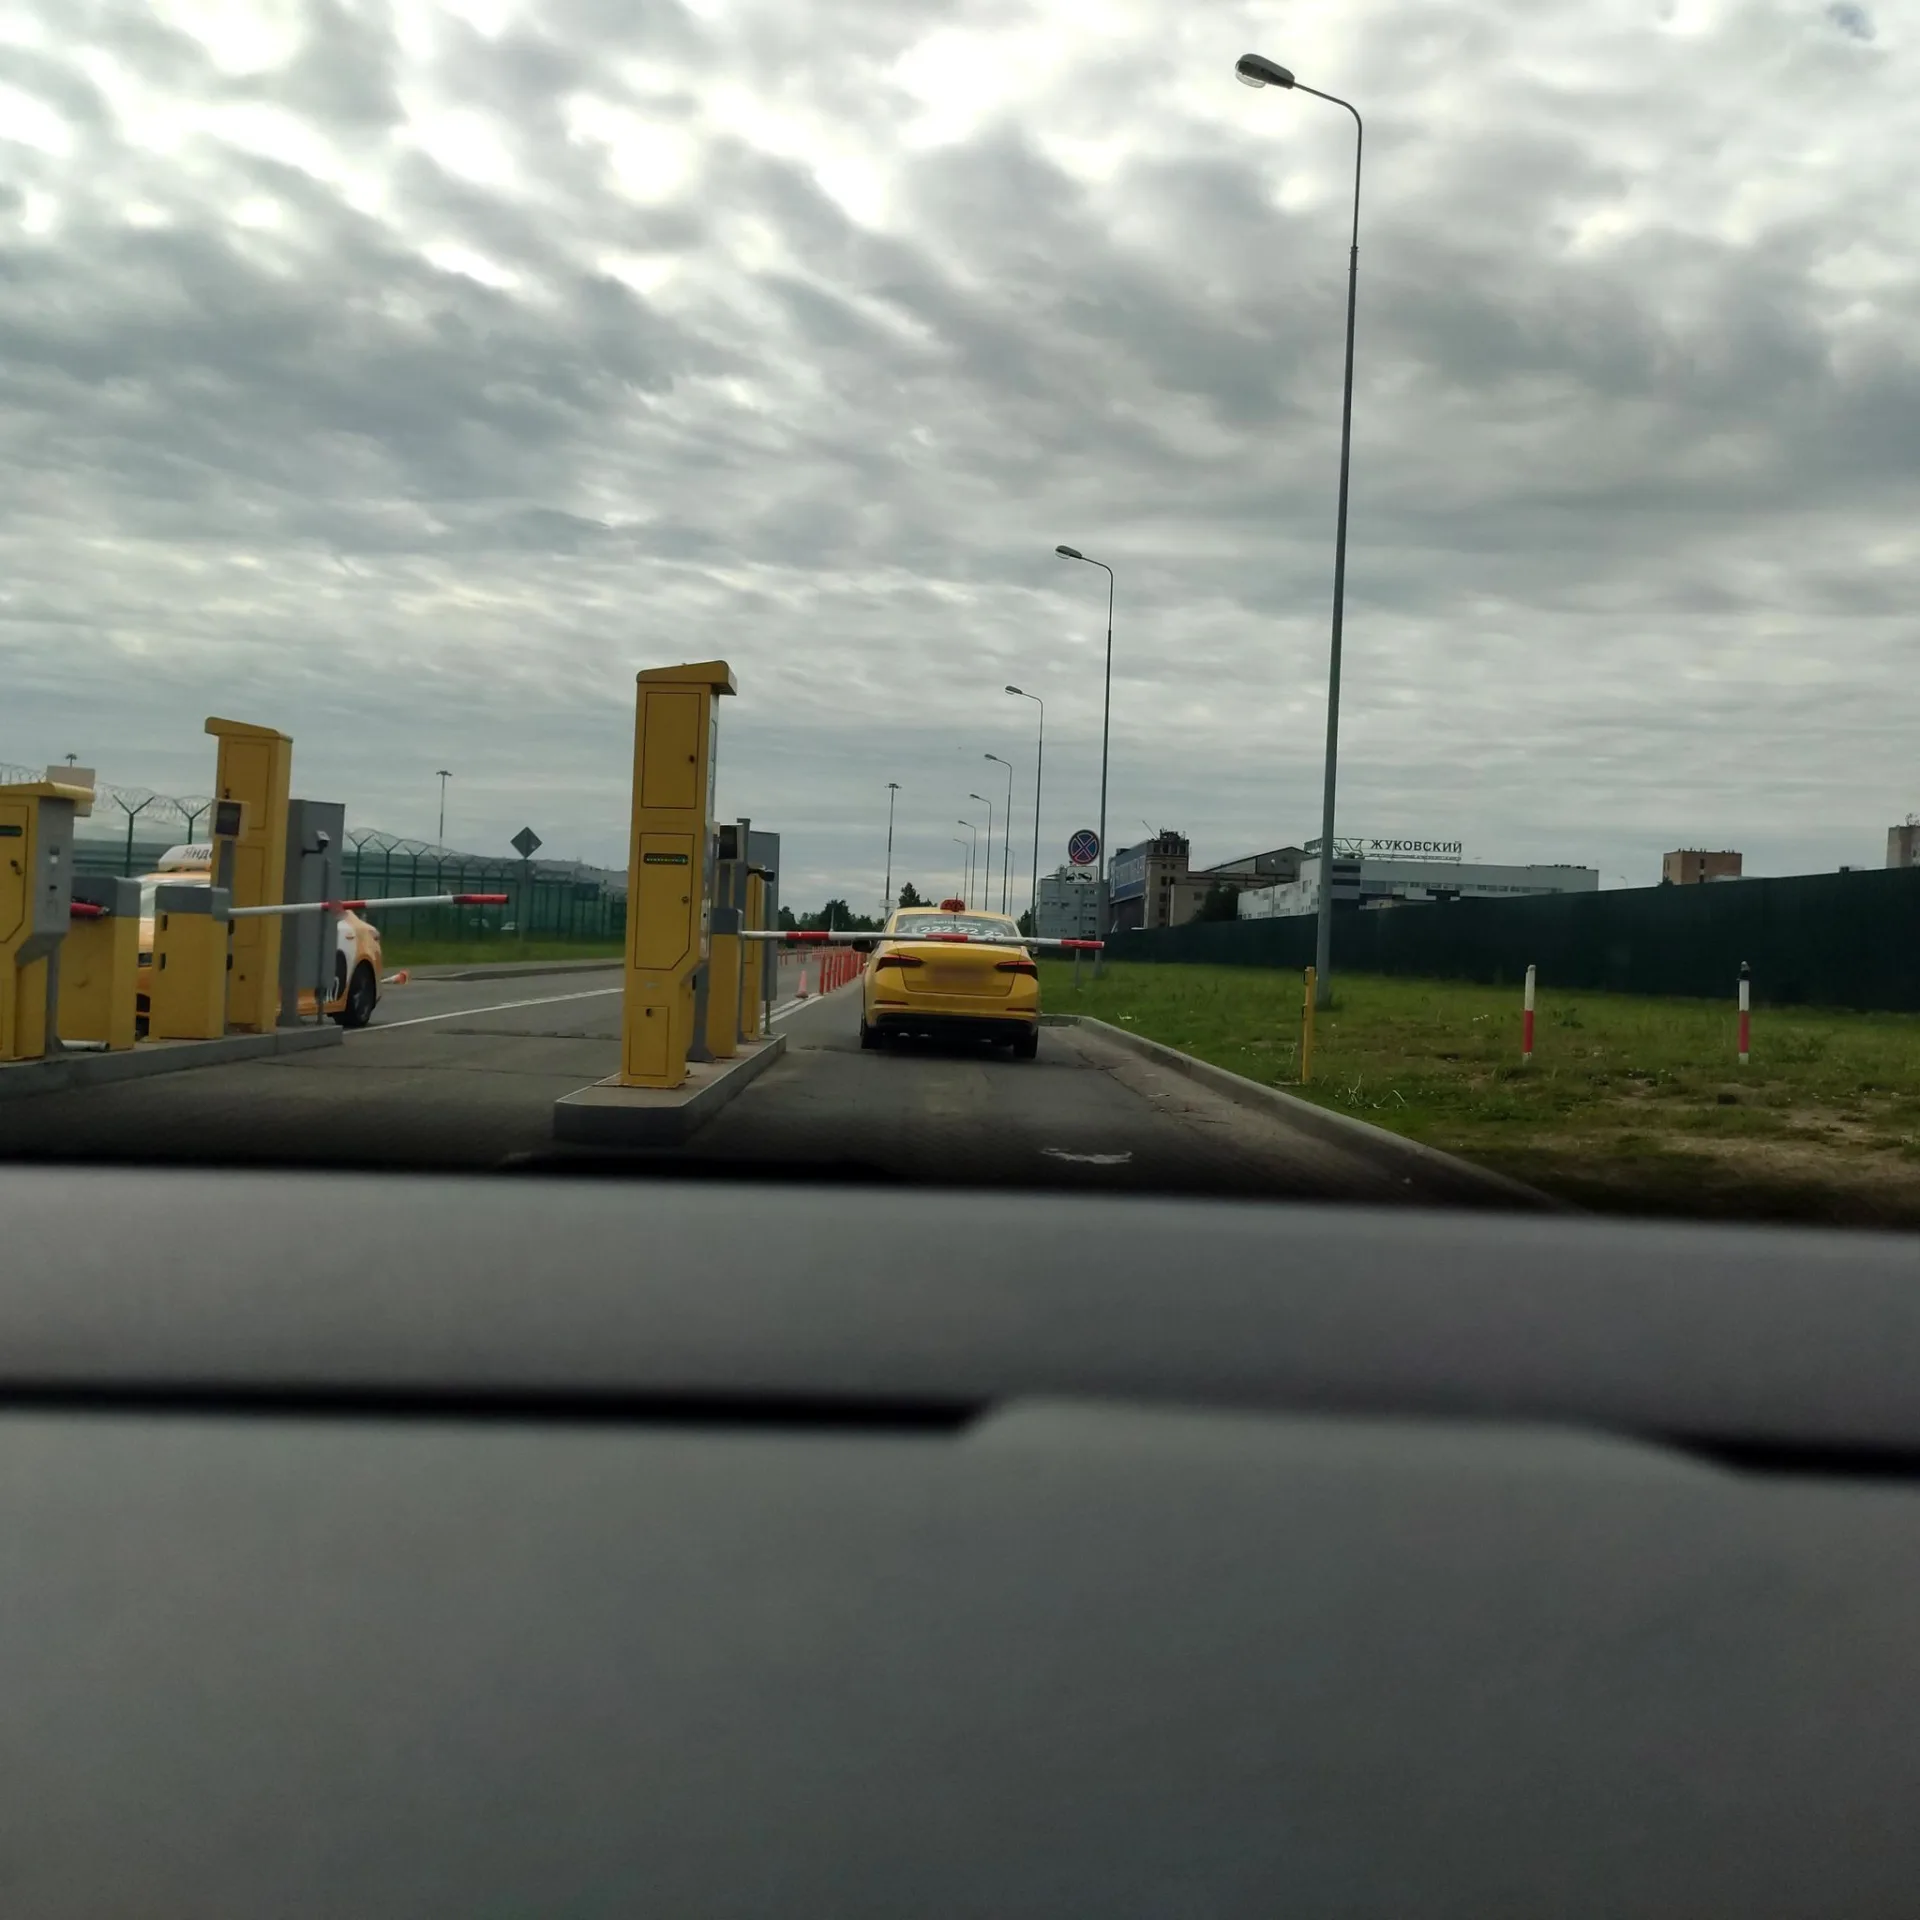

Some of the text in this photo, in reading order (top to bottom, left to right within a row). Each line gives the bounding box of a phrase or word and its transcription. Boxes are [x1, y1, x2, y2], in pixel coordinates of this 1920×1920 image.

[1370, 839, 1462, 853] ЖУКОВСКИЙ
[920, 926, 952, 934] 222
[958, 927, 979, 935] 22
